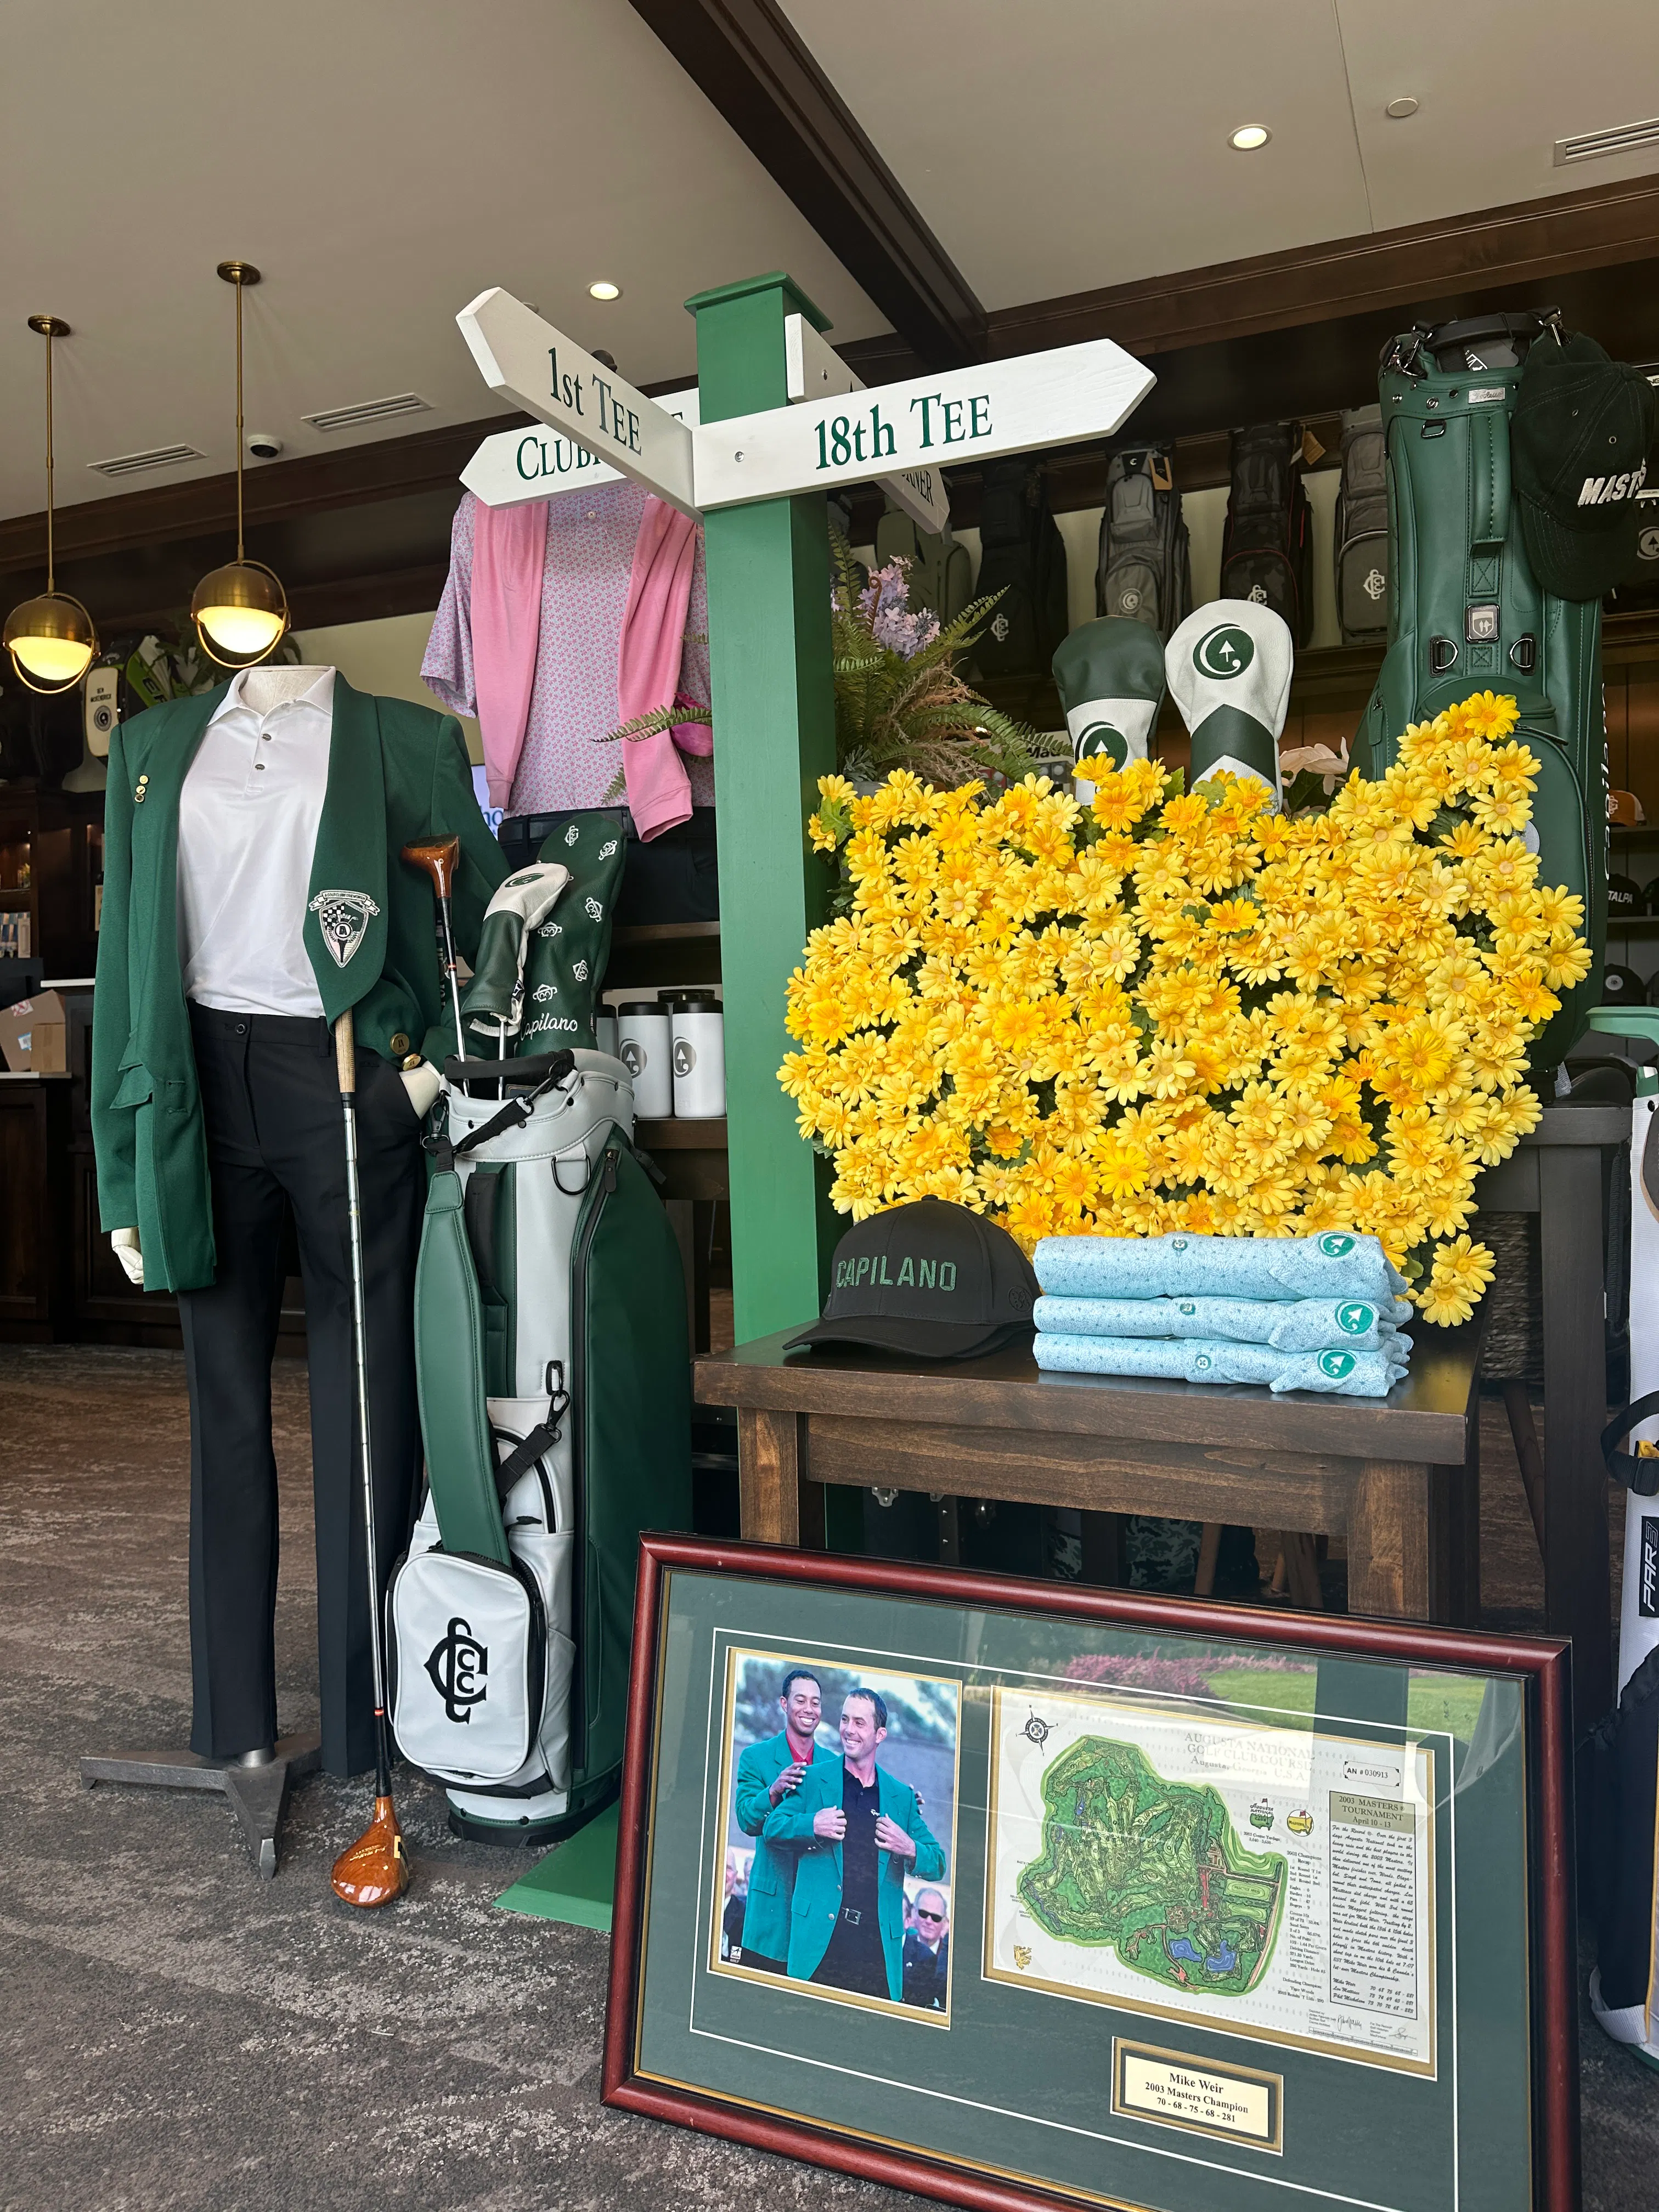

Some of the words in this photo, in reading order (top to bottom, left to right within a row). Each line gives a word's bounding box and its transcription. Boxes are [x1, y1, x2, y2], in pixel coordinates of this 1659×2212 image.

[549, 347, 584, 416] 1st
[592, 374, 642, 456] TEE
[815, 404, 898, 470] 18th
[910, 393, 994, 449] TEE
[836, 1255, 956, 1291] CAPILANO
[1184, 1733, 1243, 1749] AUGUSTA
[1190, 1756, 1229, 1770] Augusta,
[1339, 1796, 1355, 1804] 2003
[1358, 1798, 1398, 1811] MASTERS
[1342, 1805, 1403, 1821] TOURNAMENT
[1352, 1816, 1369, 1826] April
[1169, 2072, 1195, 2087] Mike
[1199, 2079, 1224, 2094] Weir
[1145, 2082, 1164, 2094] 2003
[1167, 2087, 1201, 2102] Masters
[1203, 2095, 1249, 2113] Champion
[1156, 2097, 1166, 2106] 70
[1173, 2101, 1182, 2109] 68
[1189, 2105, 1198, 2113] 75
[1205, 2109, 1215, 2117] 68
[1222, 2113, 1235, 2123] 281
